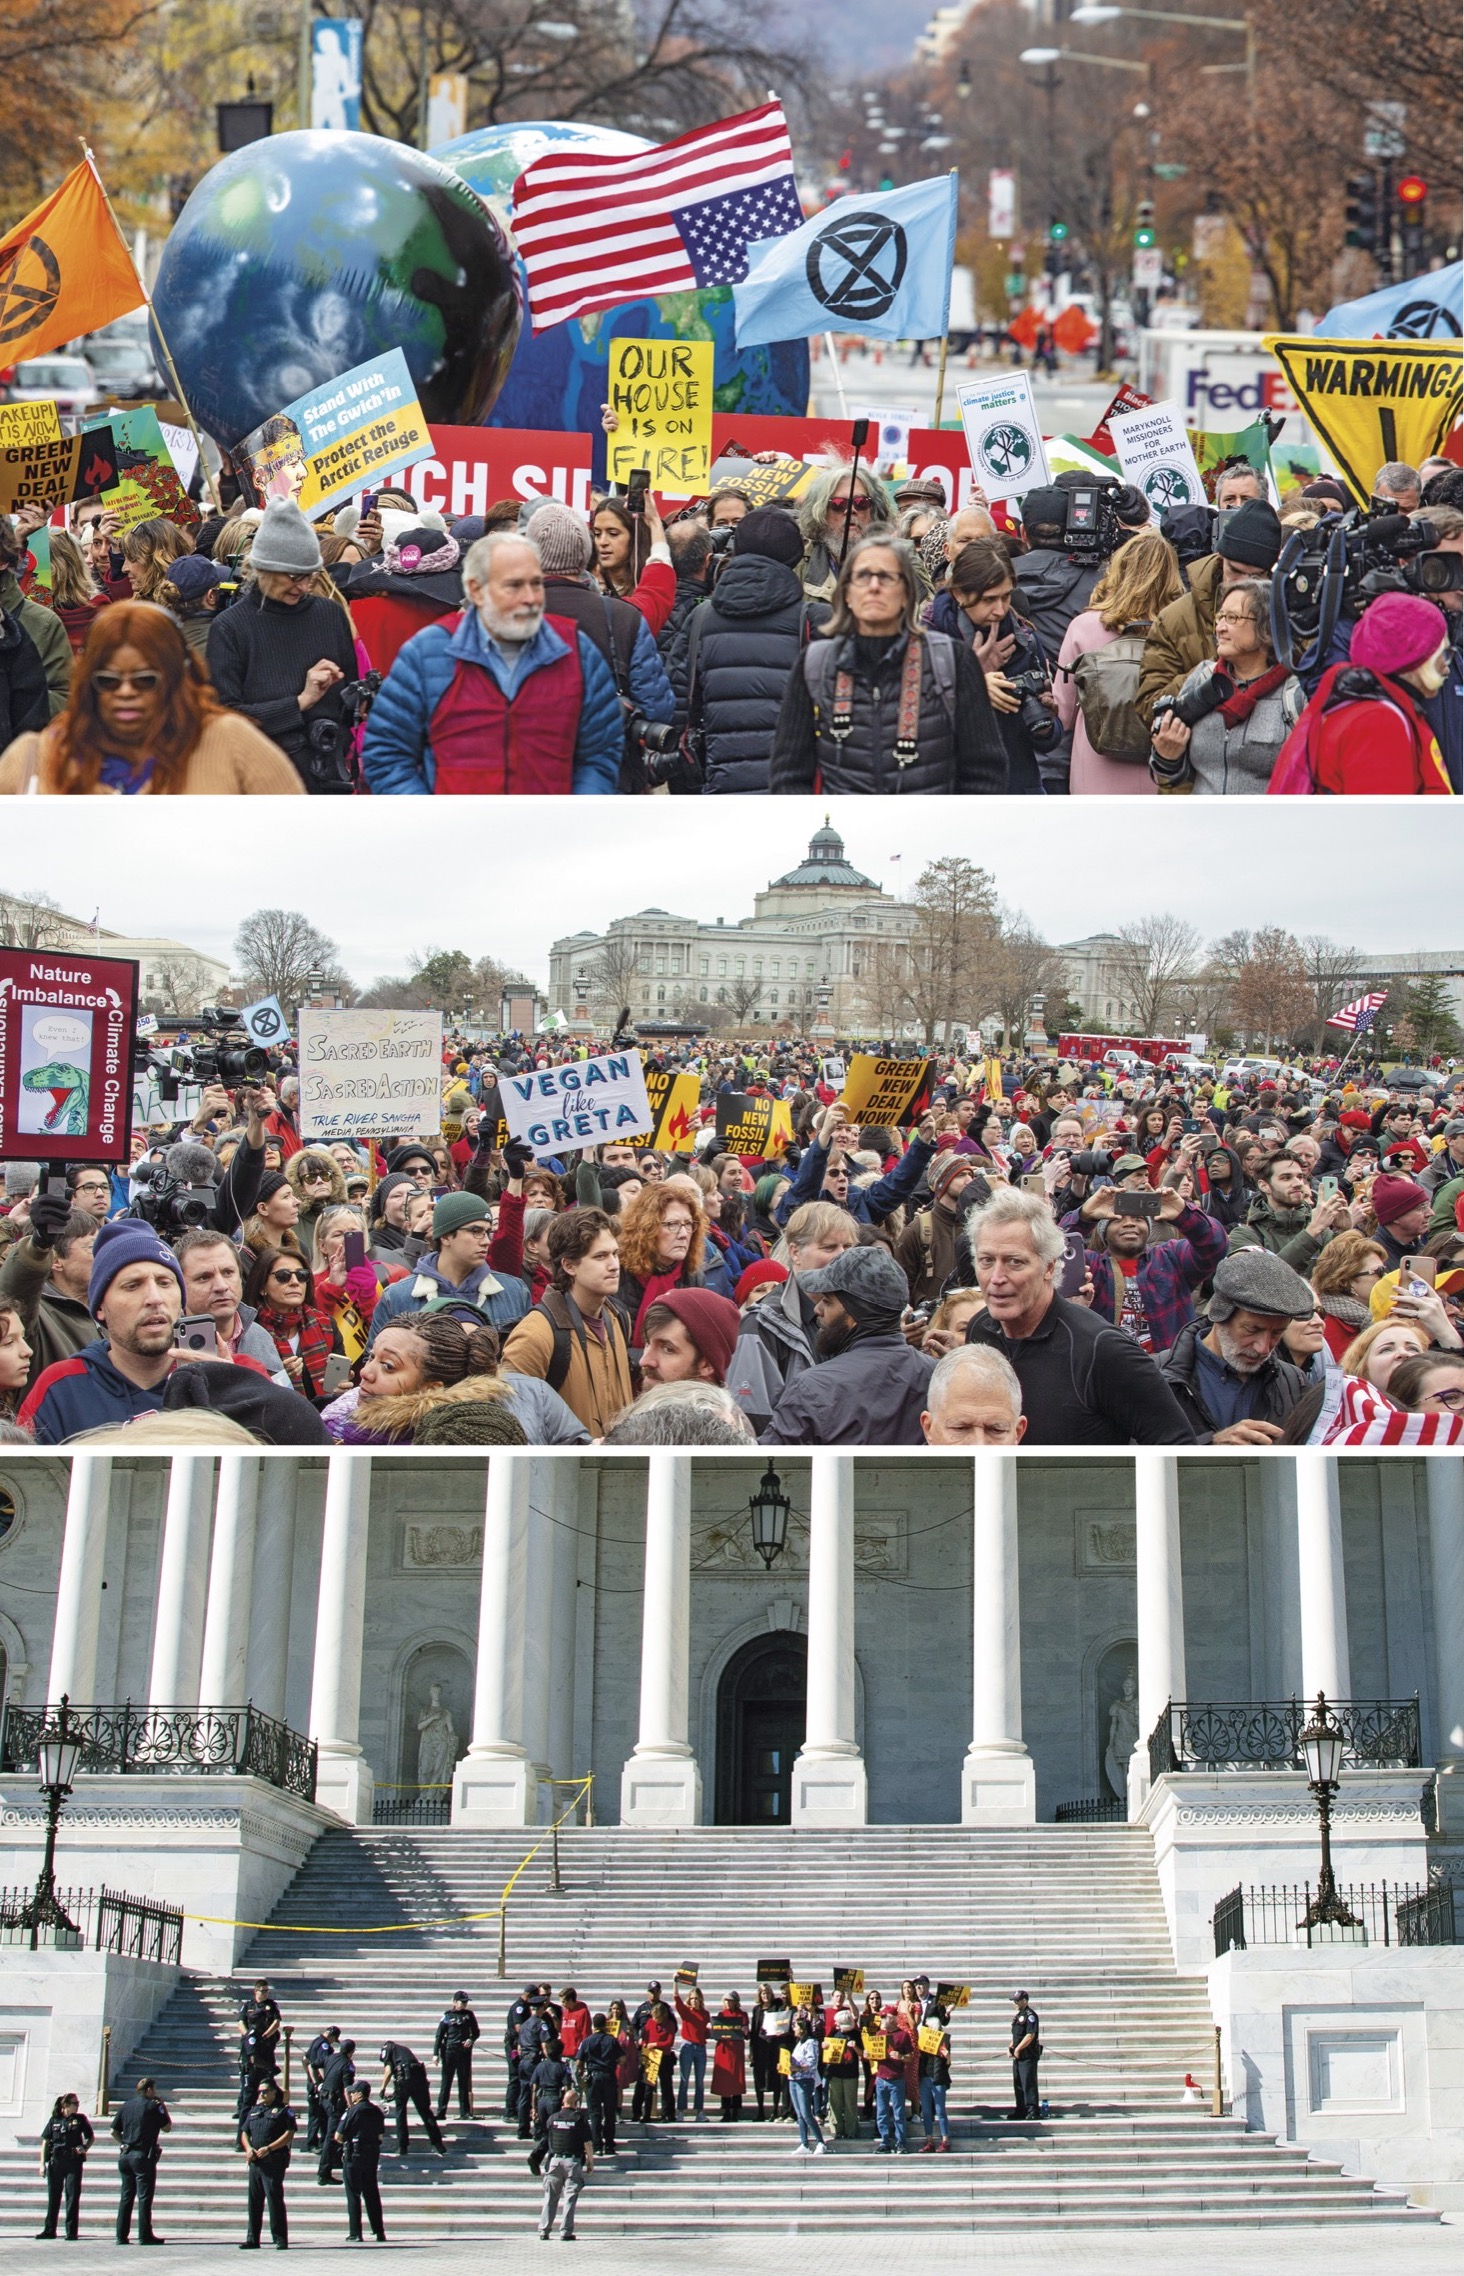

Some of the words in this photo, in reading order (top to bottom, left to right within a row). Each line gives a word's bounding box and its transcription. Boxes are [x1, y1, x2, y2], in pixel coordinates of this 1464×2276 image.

[619, 345, 694, 379] OUR
[1306, 357, 1462, 399] WARMING!
[303, 390, 346, 425] Stand
[346, 372, 385, 399] With
[613, 381, 700, 414] HOUSE
[963, 396, 989, 406] climate
[991, 390, 1015, 401] justice
[1187, 370, 1300, 411] FedE
[308, 419, 337, 442] The
[337, 385, 402, 426] Gwich'in
[981, 396, 1017, 410] matters
[23, 420, 57, 438] NOW
[632, 418, 656, 438] IS
[665, 418, 693, 434] ON
[1123, 415, 1171, 435] MARYKNOLL
[1127, 425, 1173, 444] MISSIONERS
[5, 438, 74, 463] GREEN
[312, 433, 368, 474] Protect
[368, 421, 396, 441] the
[1125, 449, 1158, 465] MOTHER
[1160, 442, 1187, 455] EARTH
[1144, 439, 1161, 449] FOR
[25, 456, 72, 480] NEW
[319, 457, 362, 491] Arctic
[362, 429, 419, 465] Refuge
[613, 445, 708, 482] FIRE!
[774, 459, 803, 473] NO
[17, 476, 68, 497] DEAL
[716, 476, 782, 497] FOSSIL
[747, 467, 796, 485] NEW
[30, 963, 92, 984] Nature
[11, 985, 107, 1008] Imbalance
[38, 1033, 57, 1041] knew
[61, 1034, 85, 1043] that!
[48, 1025, 68, 1033] Even
[105, 1009, 124, 1075] Climate
[307, 1034, 378, 1061] SACRED
[379, 1039, 432, 1059] EARTH
[512, 1056, 631, 1101] VEGAN
[874, 1061, 922, 1077] GREEN
[305, 1075, 377, 1101] SACRED
[376, 1073, 438, 1099] ACTION
[645, 1073, 669, 1091] NO
[879, 1079, 915, 1093] NEW
[99, 1079, 120, 1144] Change
[562, 1089, 596, 1120] like
[754, 1098, 770, 1112] NO
[866, 1095, 904, 1110] DEAL
[311, 1115, 341, 1127] TRUE
[343, 1112, 378, 1126] RIVER
[381, 1112, 421, 1123] SANGHA
[527, 1104, 639, 1146] GRETA
[742, 1111, 769, 1126] NEW
[853, 1110, 896, 1125] NOW!
[321, 1127, 354, 1137] MEDIA,
[355, 1125, 414, 1136] PENNSYLVANIA
[725, 1124, 765, 1141] FOSSIL
[727, 1140, 762, 1155] UELS!
